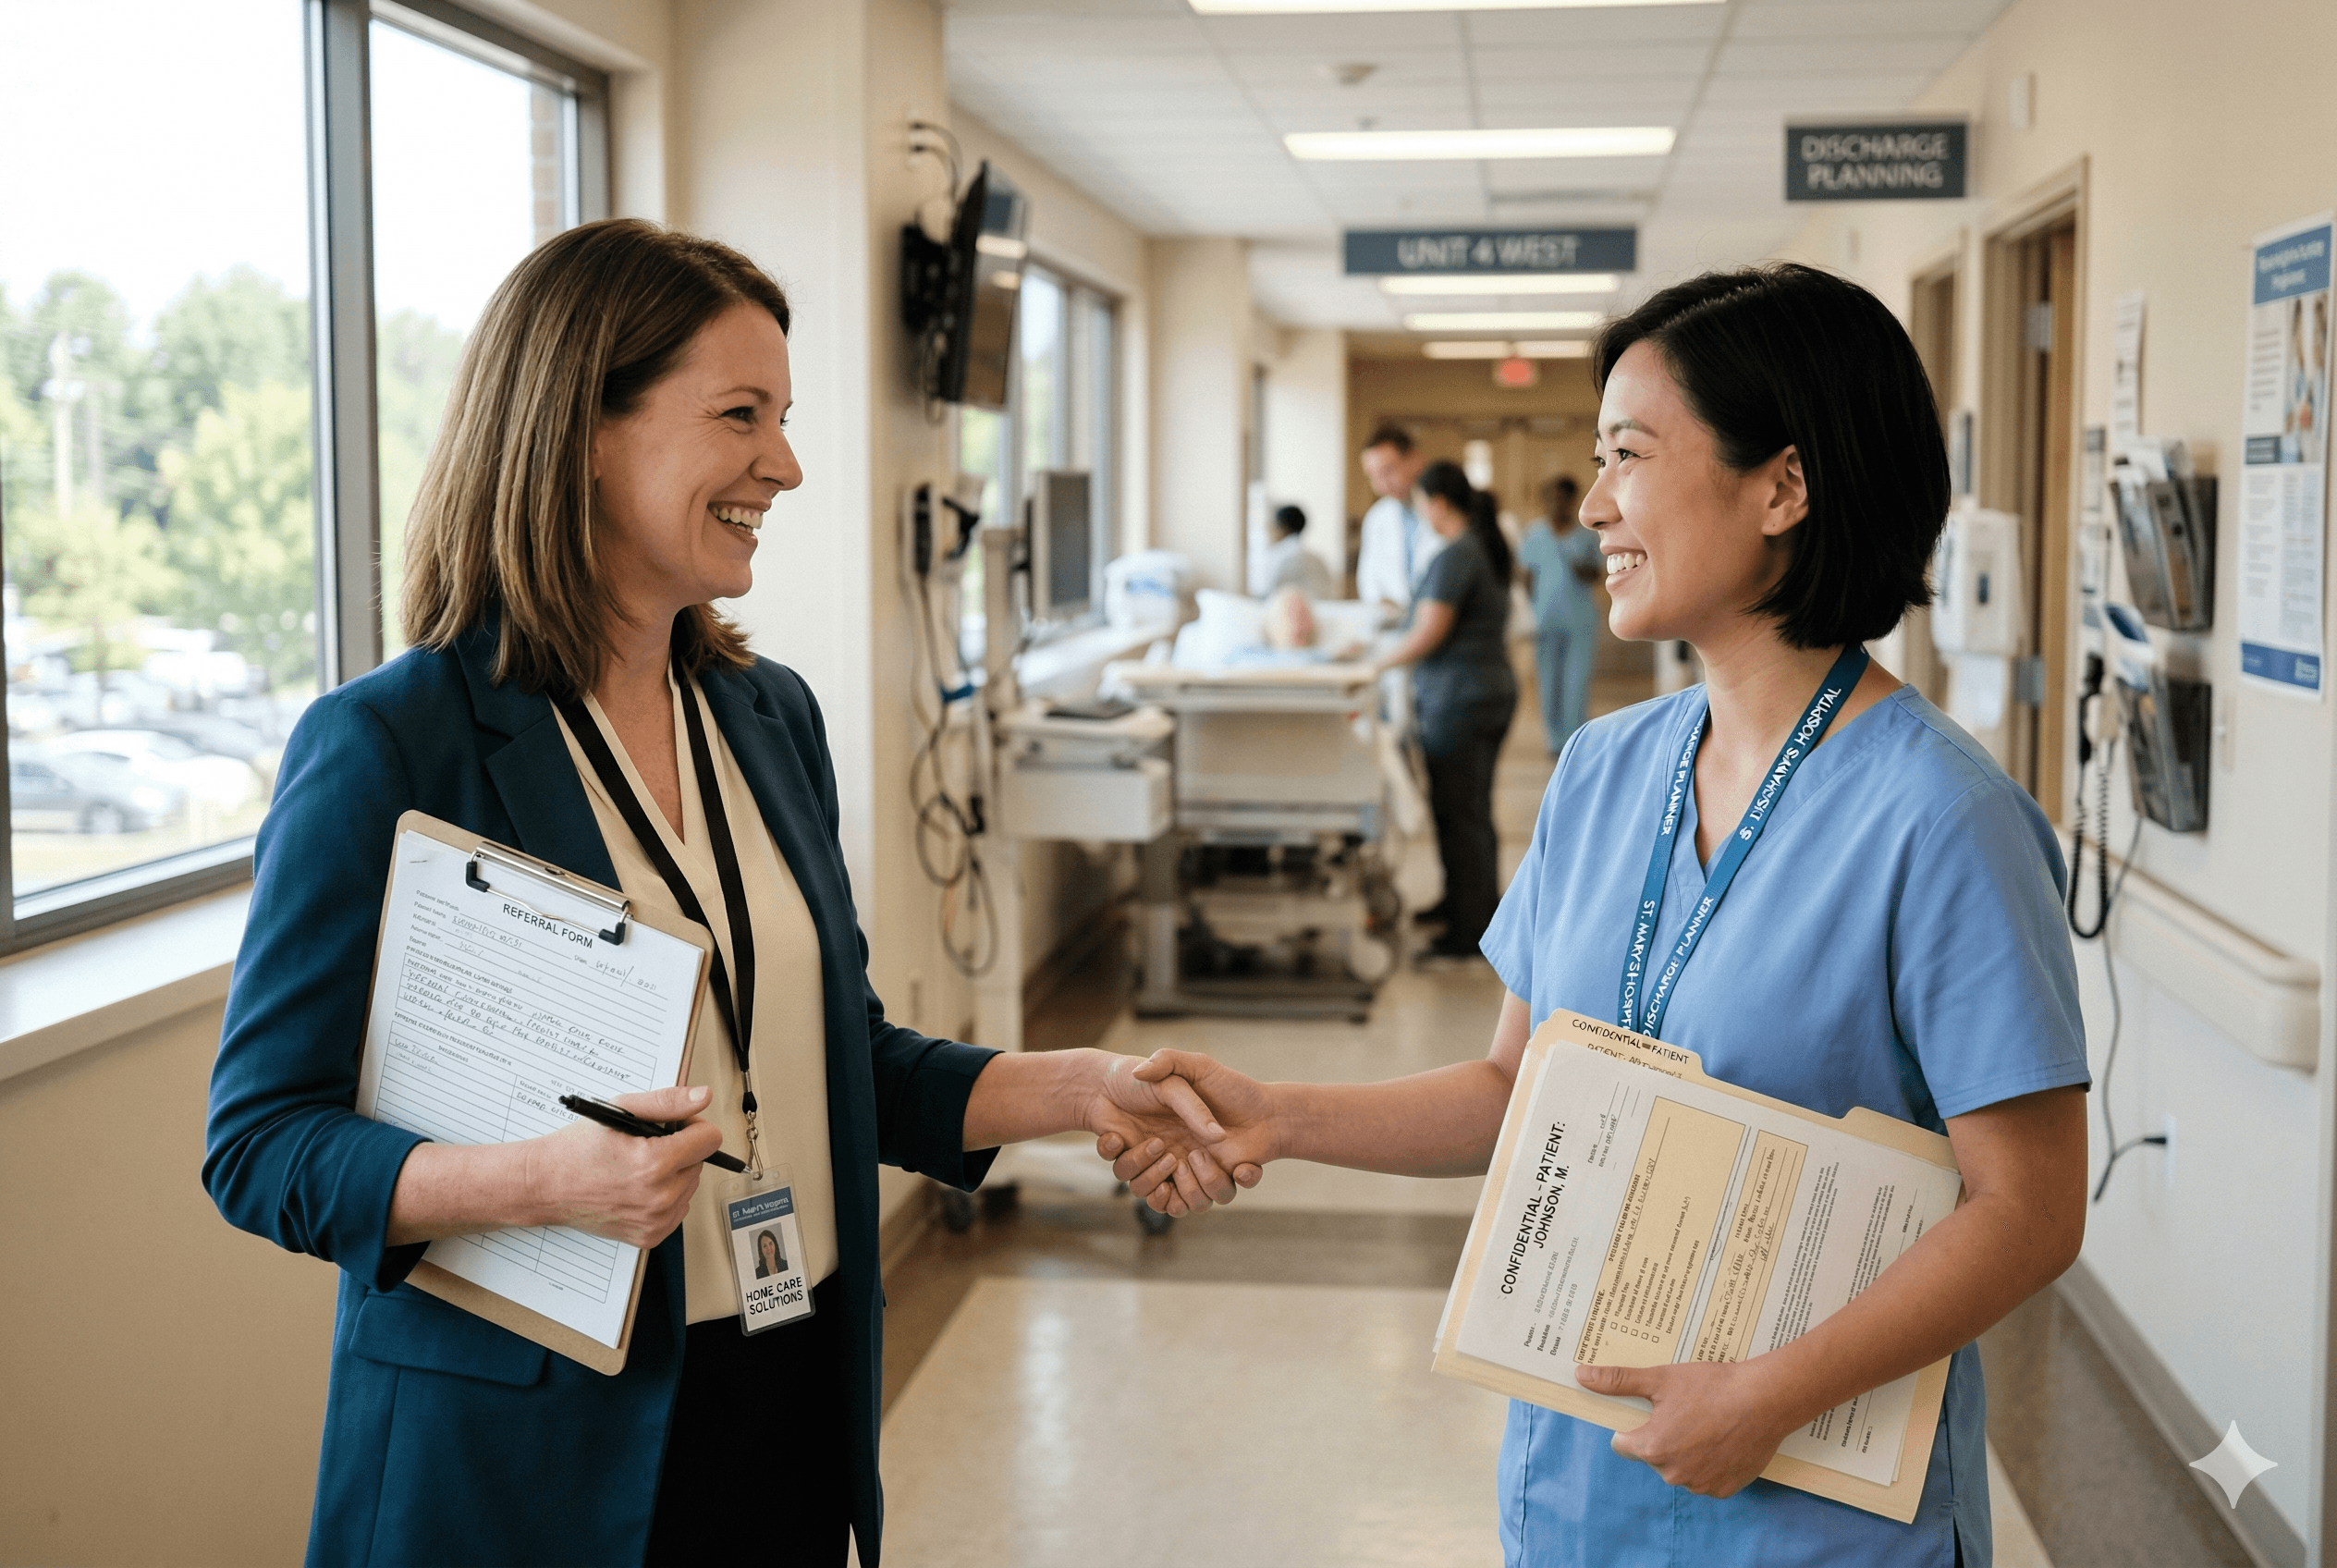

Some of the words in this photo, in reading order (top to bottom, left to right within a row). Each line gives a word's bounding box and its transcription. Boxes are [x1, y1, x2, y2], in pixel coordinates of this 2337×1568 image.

[1802, 133, 1949, 162] DISCHARGE
[1807, 162, 1943, 190] PLANNING
[1397, 235, 1470, 268] UNIT
[1471, 236, 1496, 266] 4
[1496, 234, 1579, 267] WEST
[1794, 686, 1842, 749] HOSPITAL
[502, 902, 560, 936] REFERRAL
[561, 927, 593, 949] FORM
[1638, 899, 1656, 922] ST.
[1677, 895, 1714, 957] PLANNER
[1499, 1196, 1543, 1295] CONFIDENTIAL
[1536, 1120, 1567, 1183] PATIENT:
[1534, 1184, 1568, 1249] JOHNSON,
[1554, 1164, 1571, 1182] M.
[745, 1285, 775, 1304] HOME
[776, 1276, 803, 1293] CARE
[749, 1290, 804, 1316] SOLUTIONS
